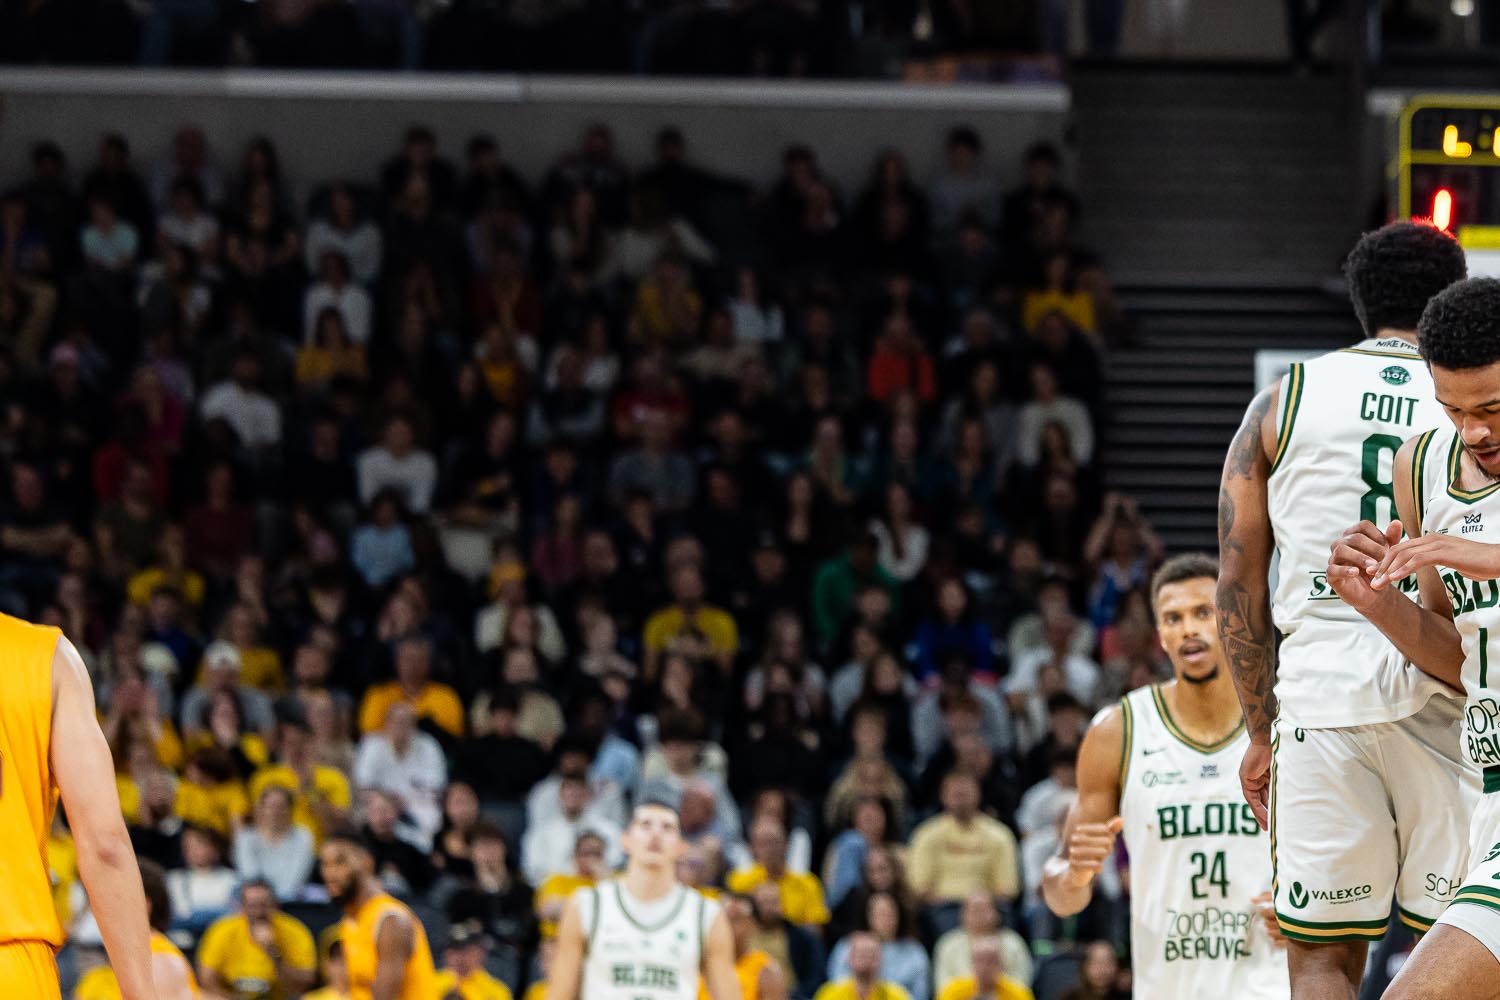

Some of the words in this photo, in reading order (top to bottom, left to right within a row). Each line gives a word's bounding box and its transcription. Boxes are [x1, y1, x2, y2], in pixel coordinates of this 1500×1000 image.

[1360, 392, 1420, 427] COIT
[1478, 627, 1488, 689] 1
[1157, 802, 1261, 841] BLOIS
[1190, 850, 1230, 900] 24
[1312, 884, 1372, 901] VALEXCO
